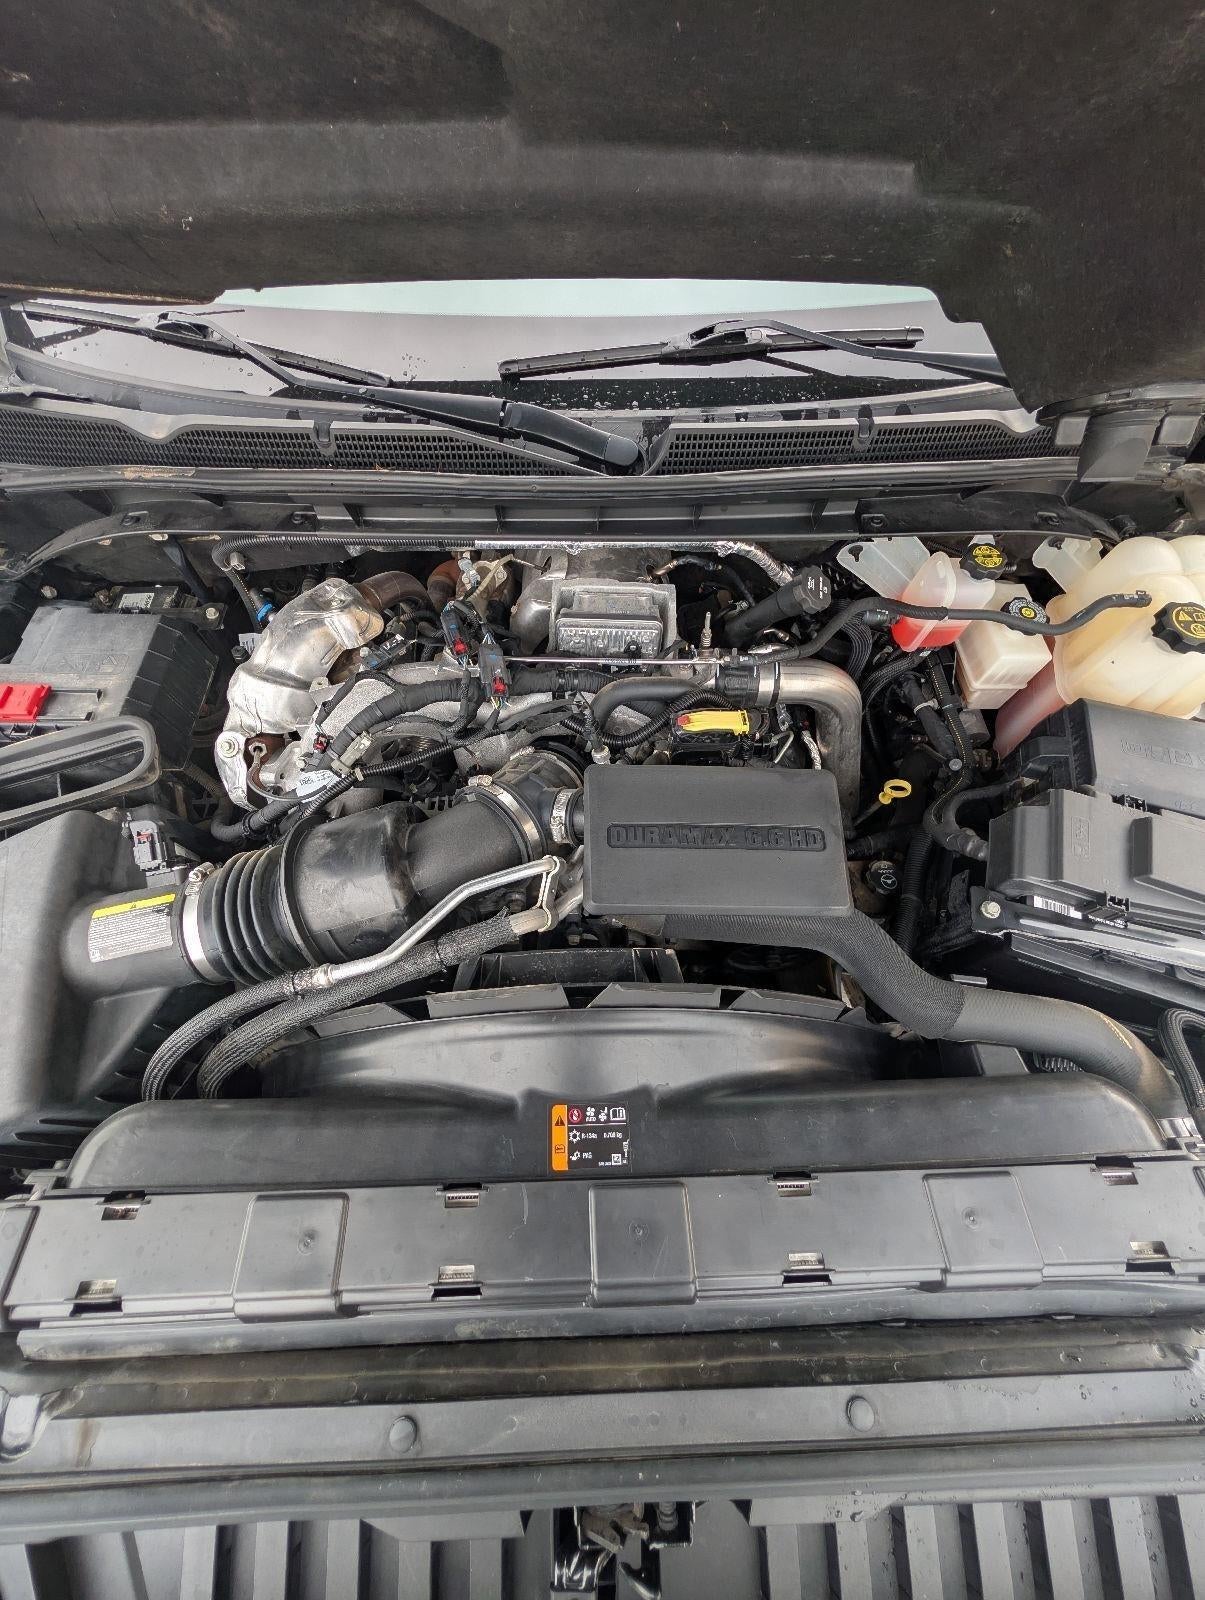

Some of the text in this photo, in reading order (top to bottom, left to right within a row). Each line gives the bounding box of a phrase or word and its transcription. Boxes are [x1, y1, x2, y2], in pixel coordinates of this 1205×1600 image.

[609, 825, 824, 849] DURAMAX 6.6 HD
